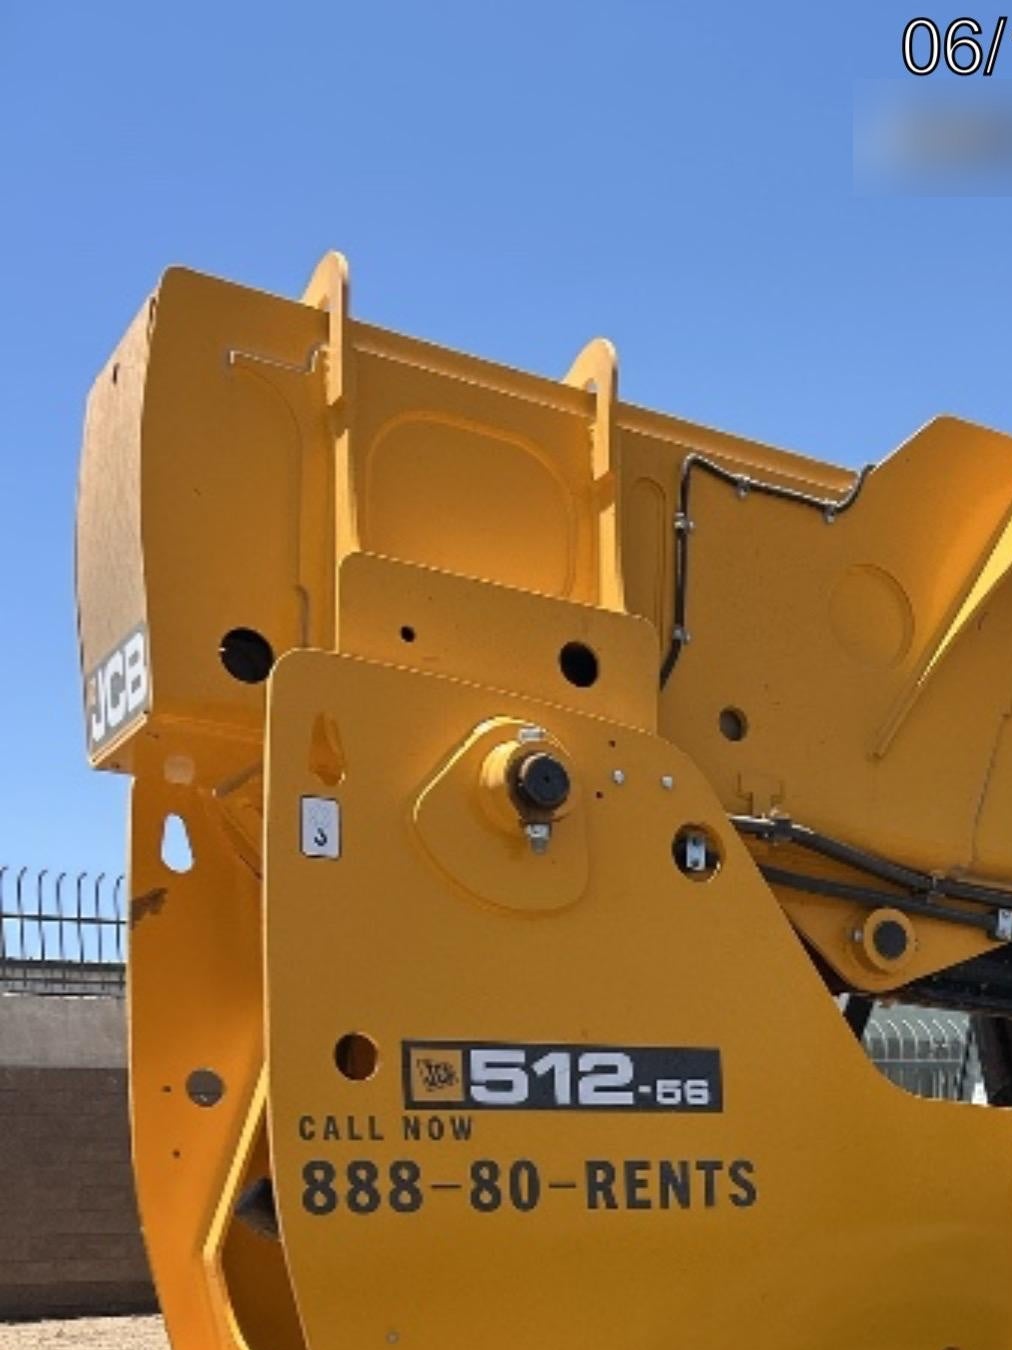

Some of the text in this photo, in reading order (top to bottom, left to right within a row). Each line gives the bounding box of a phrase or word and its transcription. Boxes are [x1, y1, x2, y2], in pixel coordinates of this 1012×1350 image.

[91, 631, 148, 742] JCB
[470, 1049, 710, 1106] 512-56
[299, 1115, 474, 1141] CALL NOW
[302, 1159, 758, 1215] 888-80-RENTS
